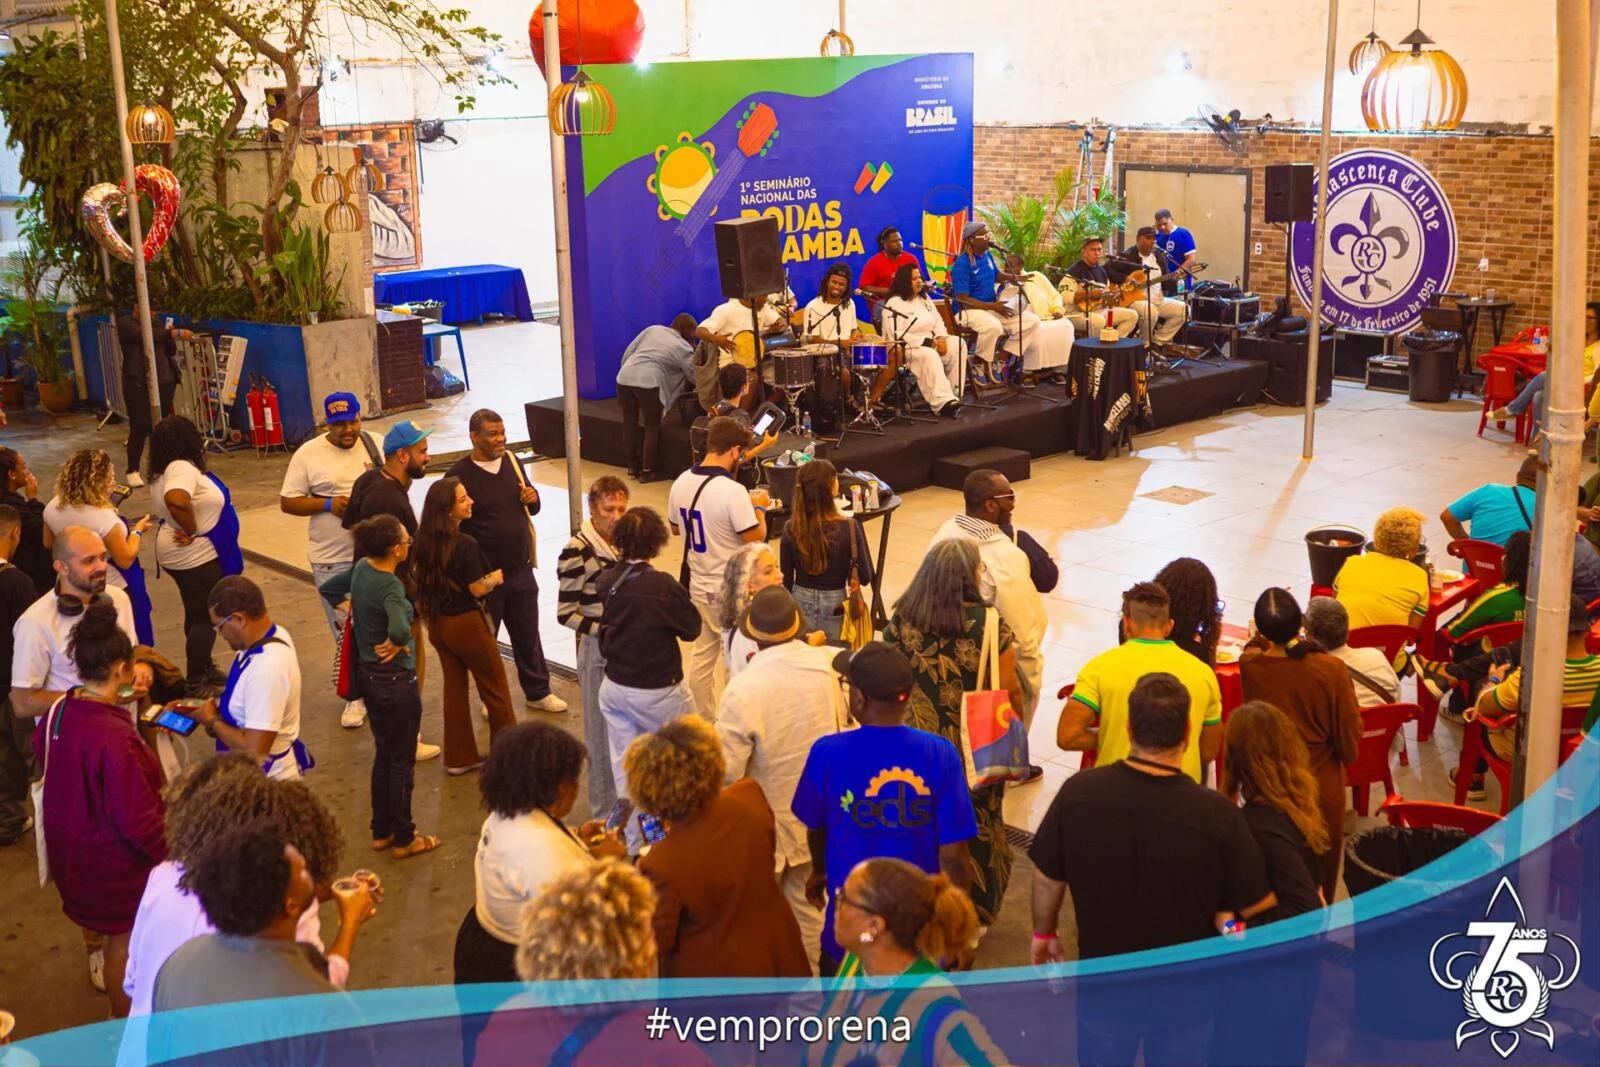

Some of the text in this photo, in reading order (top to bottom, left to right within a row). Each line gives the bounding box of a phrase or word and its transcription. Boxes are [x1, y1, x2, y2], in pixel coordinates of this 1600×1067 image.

[906, 106, 957, 128] BRASIL
[740, 176, 811, 193] 1º SEMINÁRIO
[741, 188, 817, 206] NACIONAL DAS
[1401, 172, 1440, 232] Clube
[781, 228, 865, 264] AMBA
[1324, 304, 1339, 318] em
[1339, 310, 1350, 324] 17
[1351, 315, 1362, 328] de
[1408, 300, 1422, 314] de
[1417, 277, 1437, 302] 1951
[680, 507, 707, 553] 10
[851, 782, 932, 829] eds
